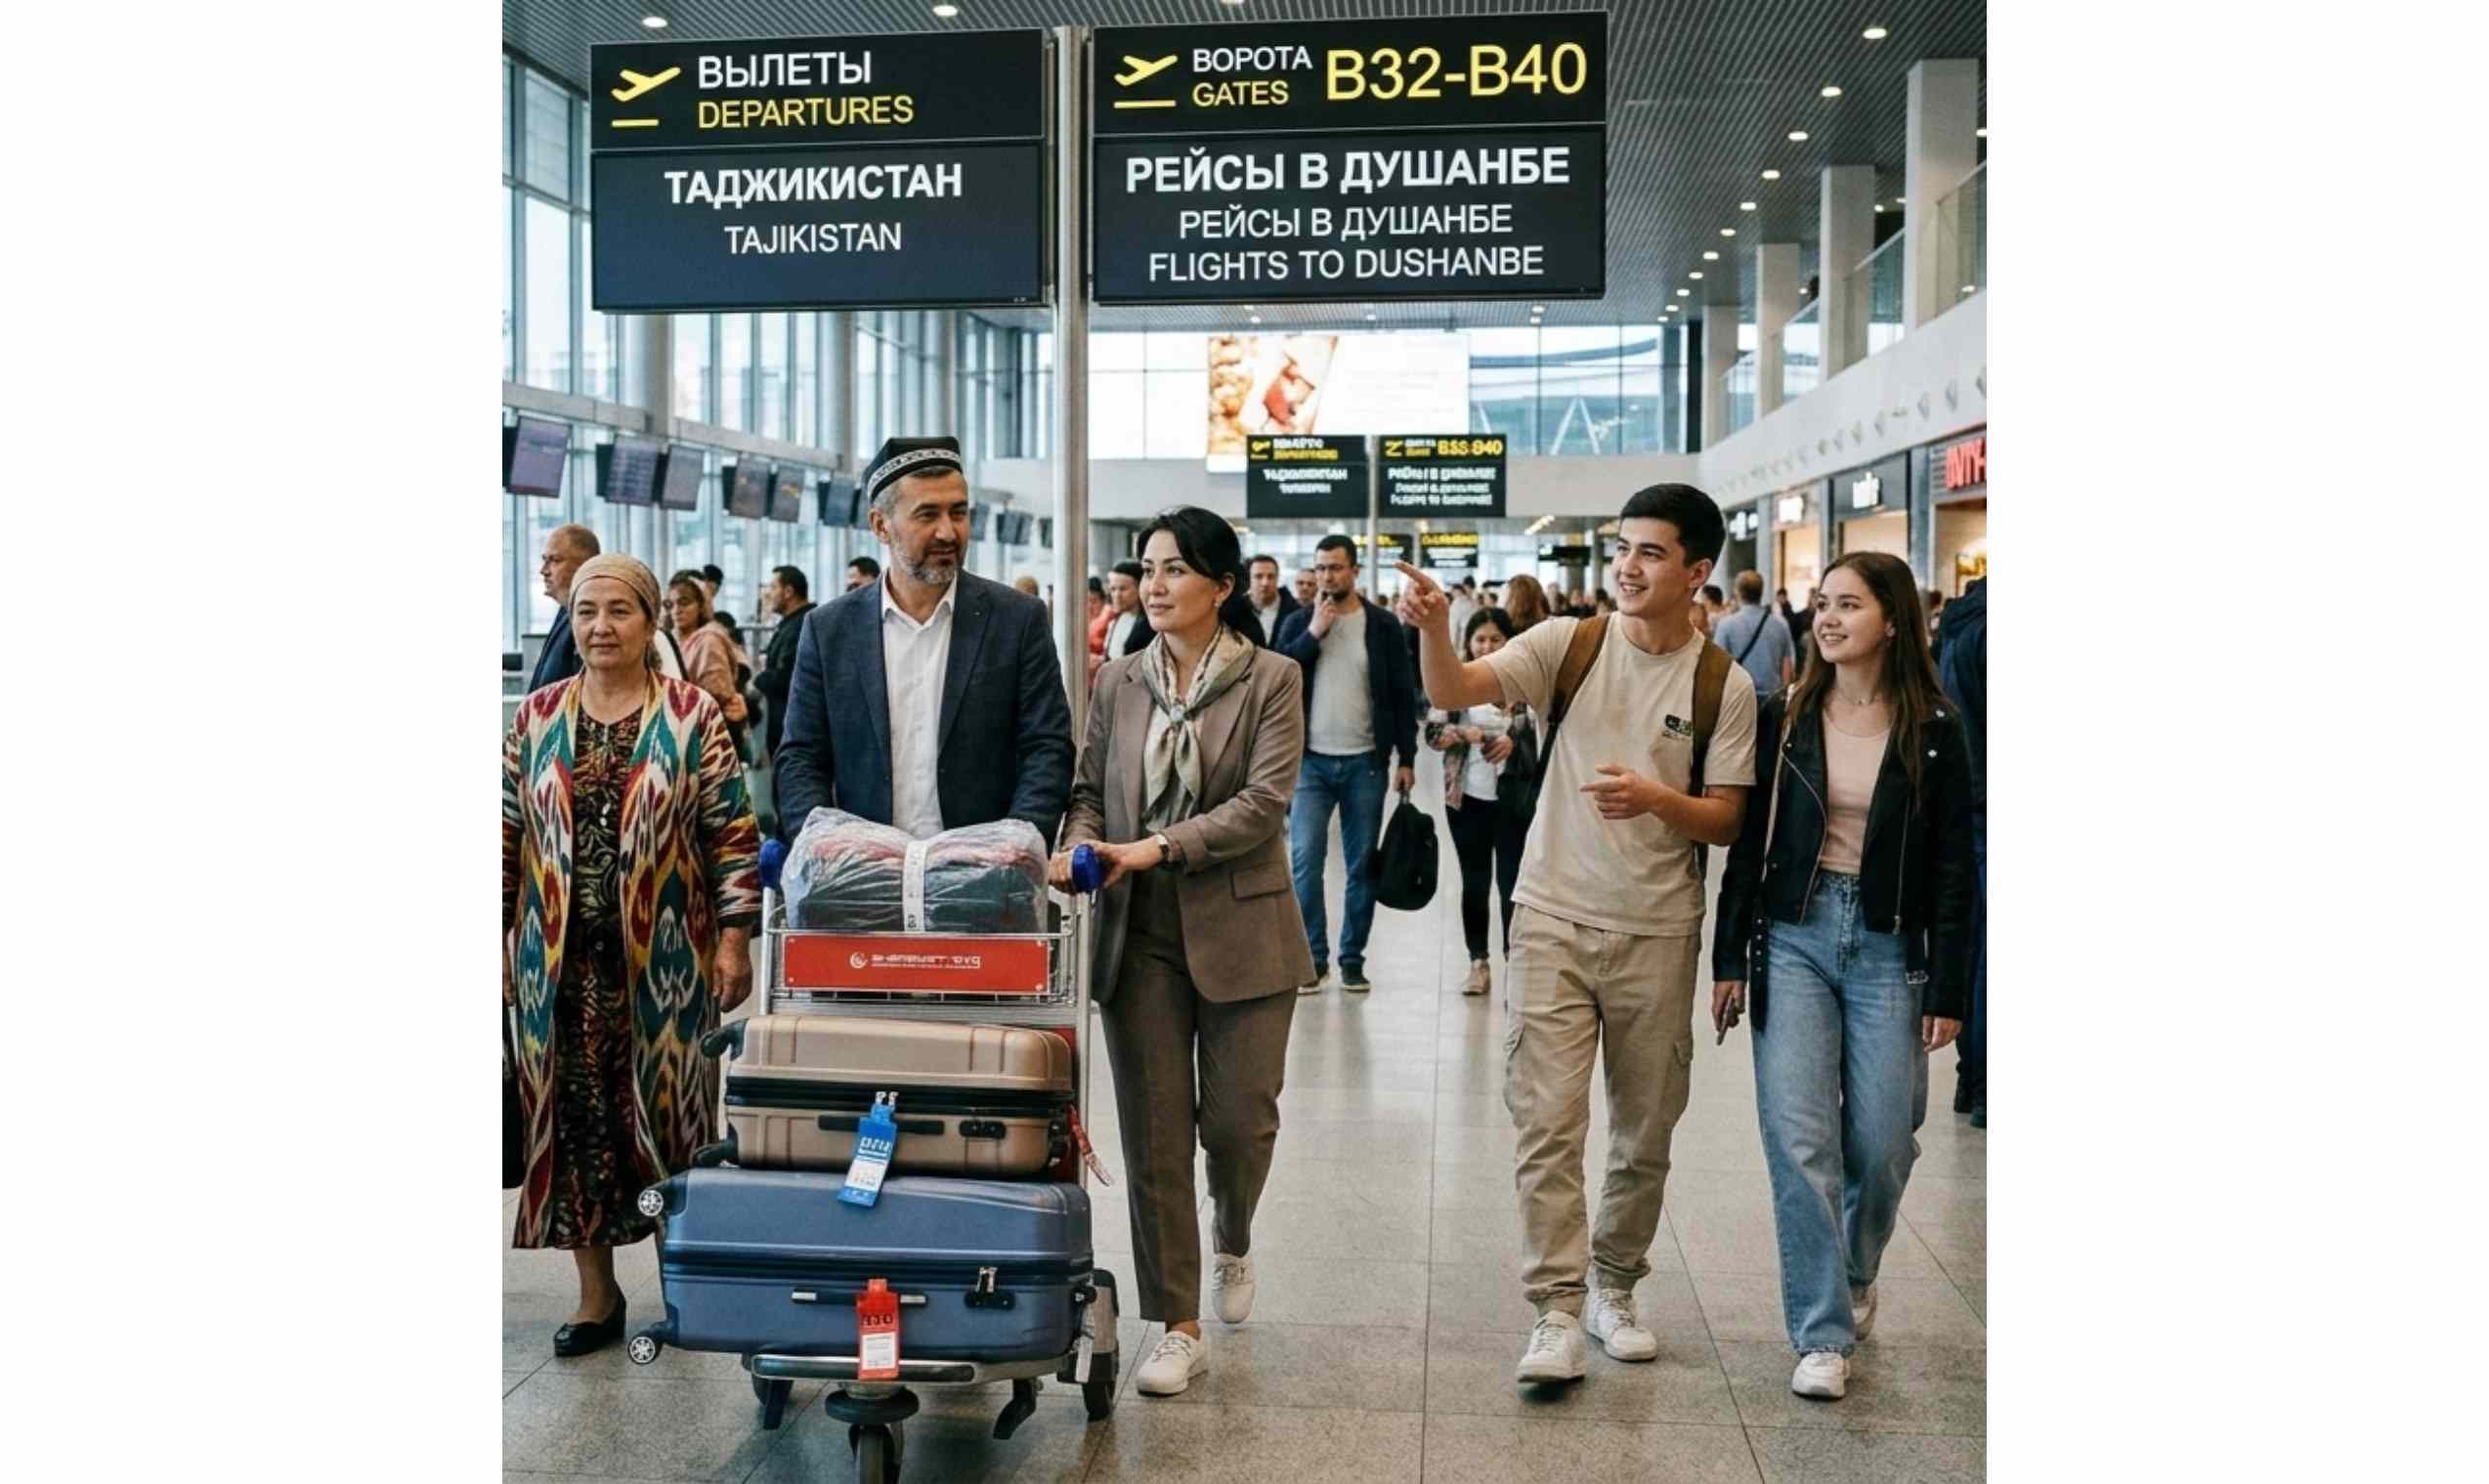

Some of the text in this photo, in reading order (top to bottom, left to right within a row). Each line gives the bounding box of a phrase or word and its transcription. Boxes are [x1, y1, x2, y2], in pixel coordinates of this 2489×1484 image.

[699, 51, 871, 88] ВЫЛЕТЫ
[1193, 46, 1312, 71] ВОРОТА
[1326, 43, 1587, 101] B32-B40
[1193, 80, 1288, 106] GATES
[699, 95, 914, 128] DEPARTURES
[665, 163, 963, 209] ТАДЖИКИСТАН
[1127, 147, 1569, 193] РЕЙСЫ В ДУШАНБЕ
[724, 223, 901, 254] TAJIKISTAN
[1180, 204, 1512, 241] РЕЙСЫ В ДУШАНБЕ
[1149, 246, 1543, 281] FLIGHTS TO DUSHANBE
